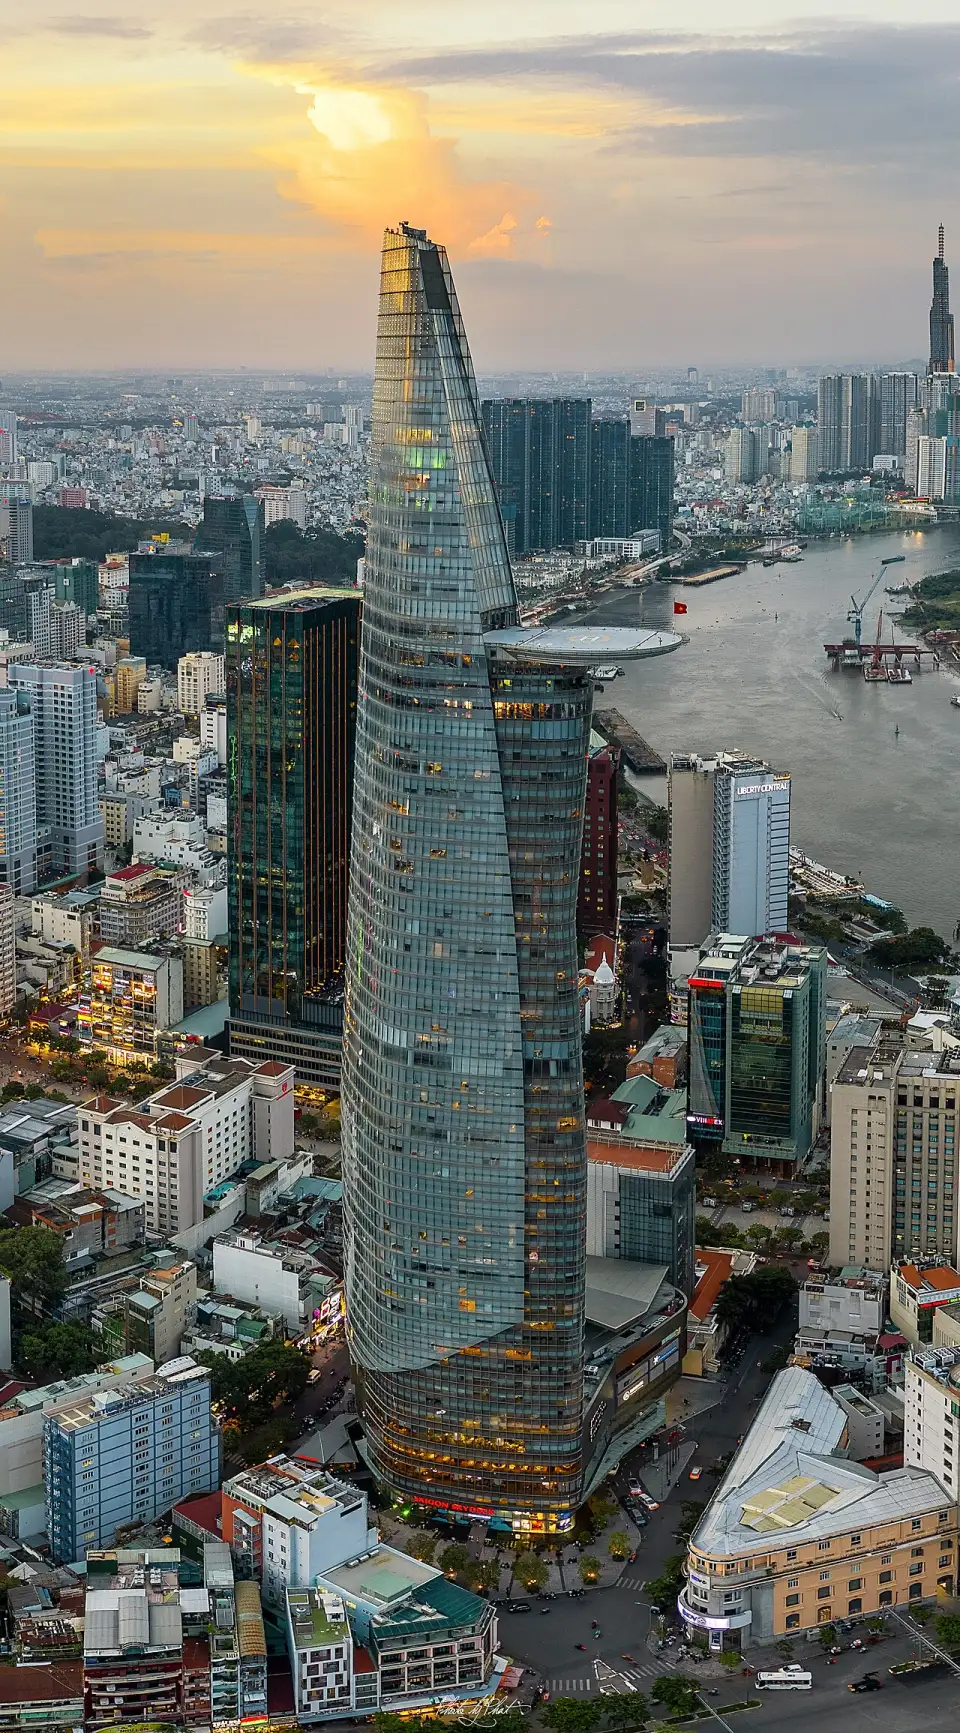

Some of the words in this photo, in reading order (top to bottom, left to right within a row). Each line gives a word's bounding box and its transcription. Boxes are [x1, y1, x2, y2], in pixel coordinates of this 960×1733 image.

[737, 785, 761, 795] LIBERTY
[760, 782, 788, 792] CENTRAL
[412, 1495, 449, 1509] SAIGON
